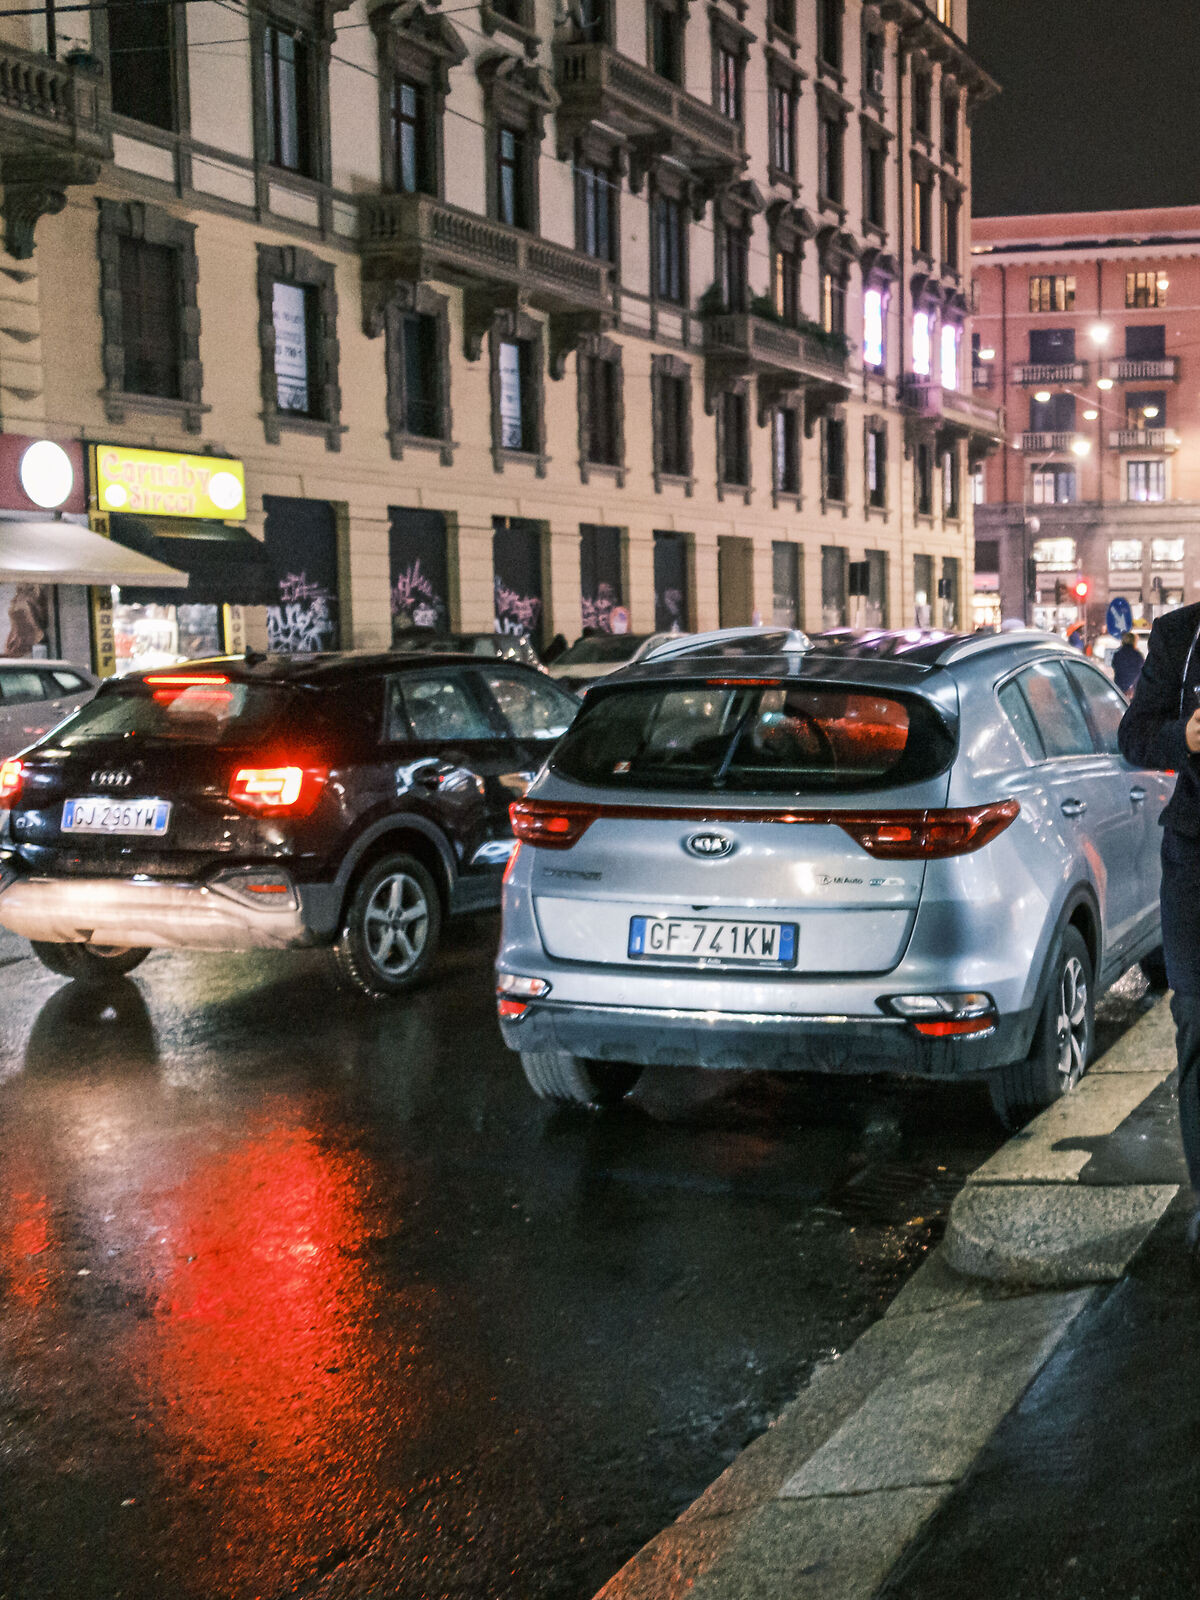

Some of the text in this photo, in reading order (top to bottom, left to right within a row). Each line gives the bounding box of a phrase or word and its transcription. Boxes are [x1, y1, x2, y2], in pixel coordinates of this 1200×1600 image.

[102, 452, 210, 495] Carnaby
[129, 484, 197, 514] Street
[101, 806, 156, 827] 296YW
[650, 922, 682, 951] GF
[692, 924, 776, 956] 741KW
